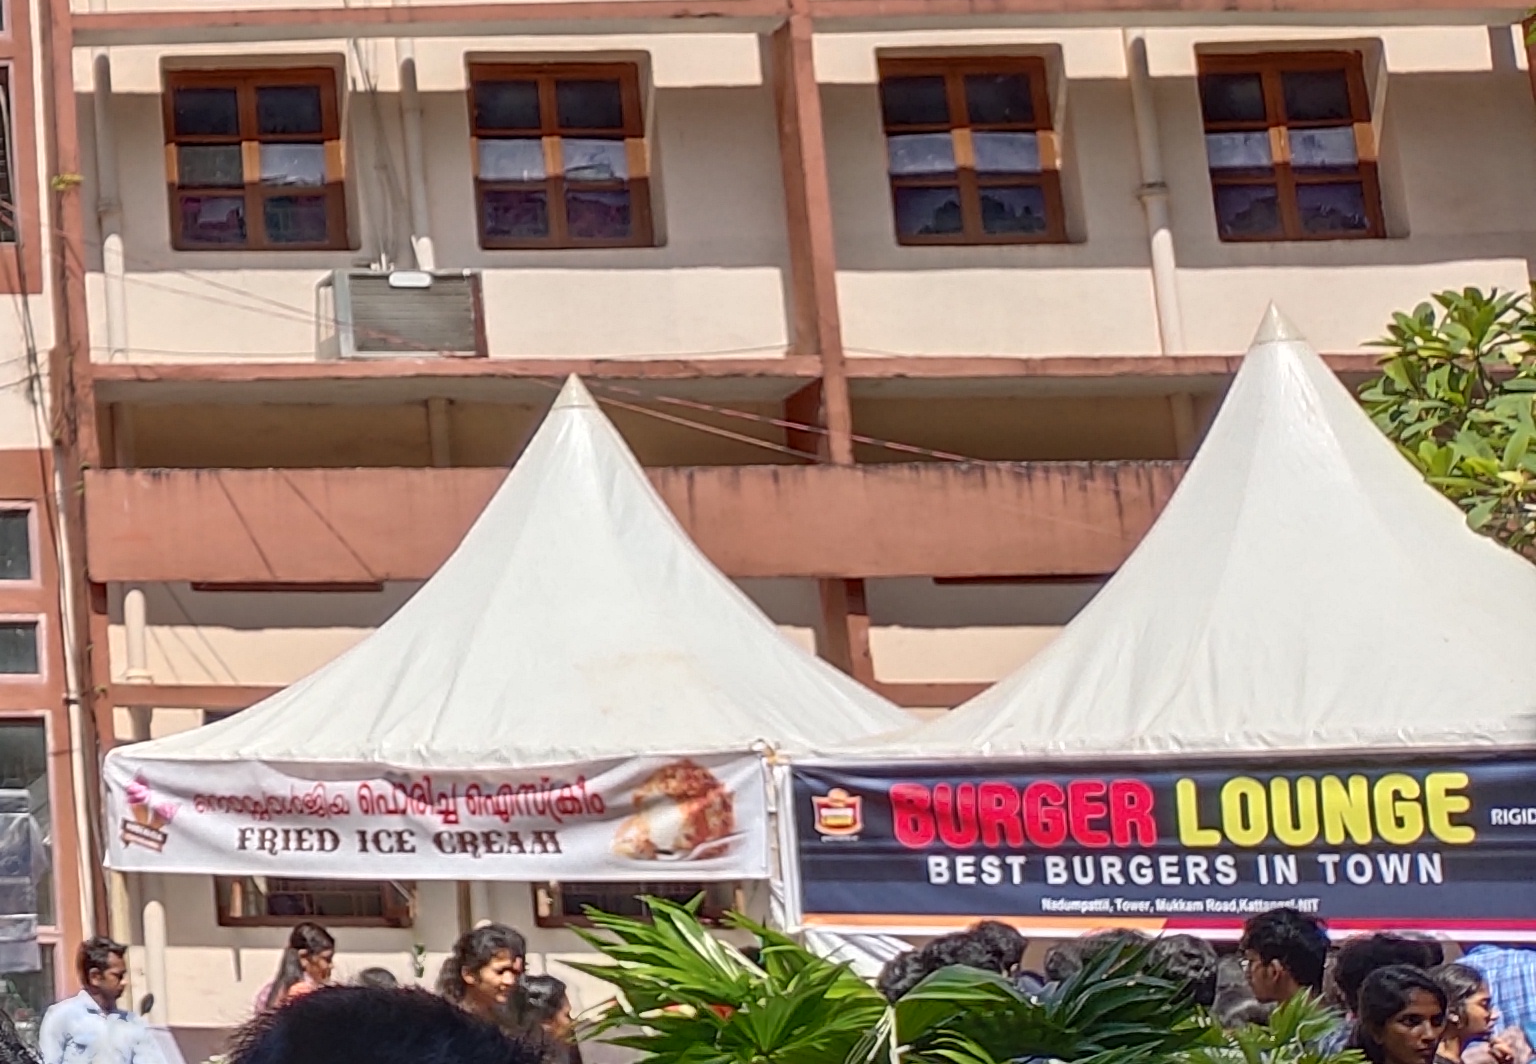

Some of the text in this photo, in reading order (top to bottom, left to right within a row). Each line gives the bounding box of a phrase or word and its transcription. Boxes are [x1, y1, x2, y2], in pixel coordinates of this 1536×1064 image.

[889, 772, 1476, 849] BURGER LOUNGE
[236, 827, 563, 858] FRIED ICE CREAM
[927, 852, 1444, 885] BEST BURGERS IN TOWN
